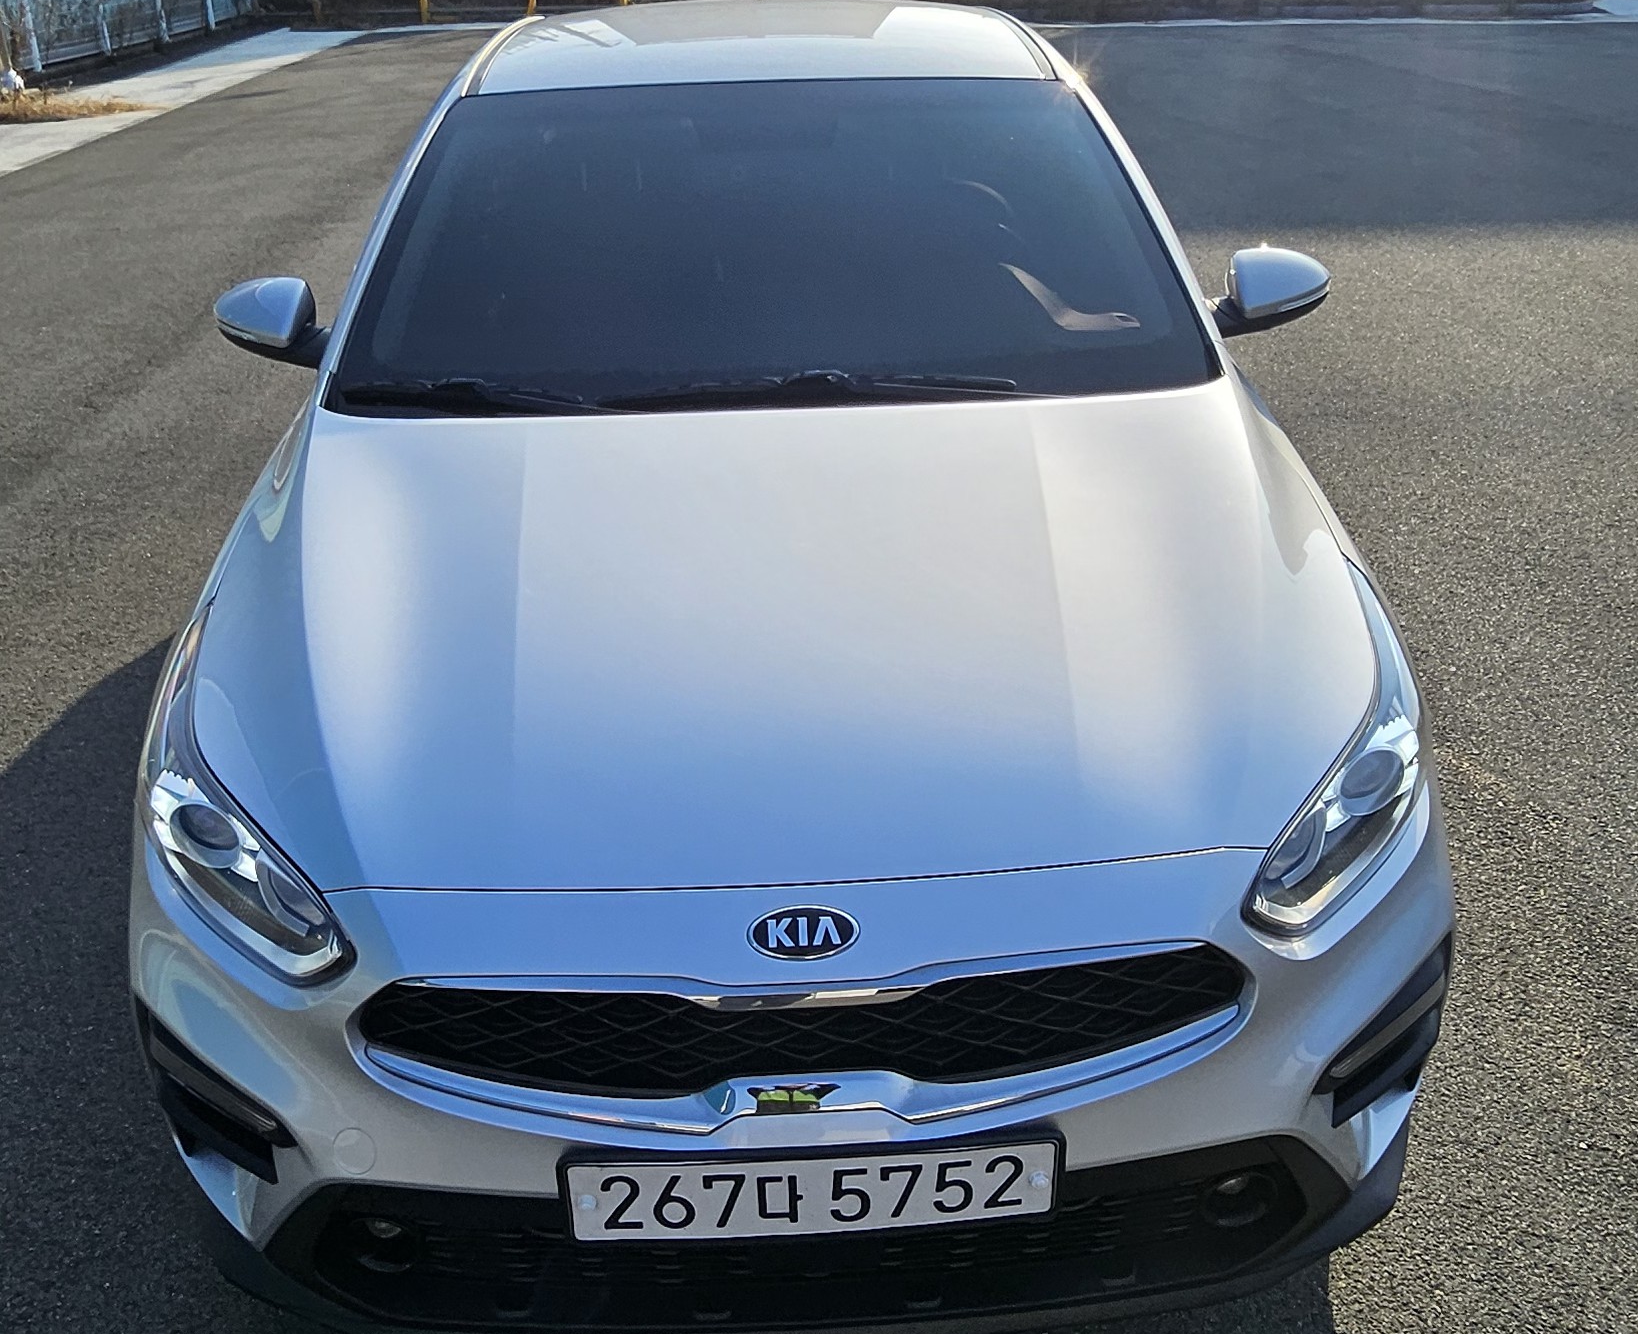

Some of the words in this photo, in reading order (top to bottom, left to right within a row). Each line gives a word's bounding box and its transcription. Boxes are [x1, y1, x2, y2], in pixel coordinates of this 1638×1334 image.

[766, 916, 842, 948] KIA
[600, 1174, 804, 1231] 267다
[830, 1155, 1025, 1223] 5752
